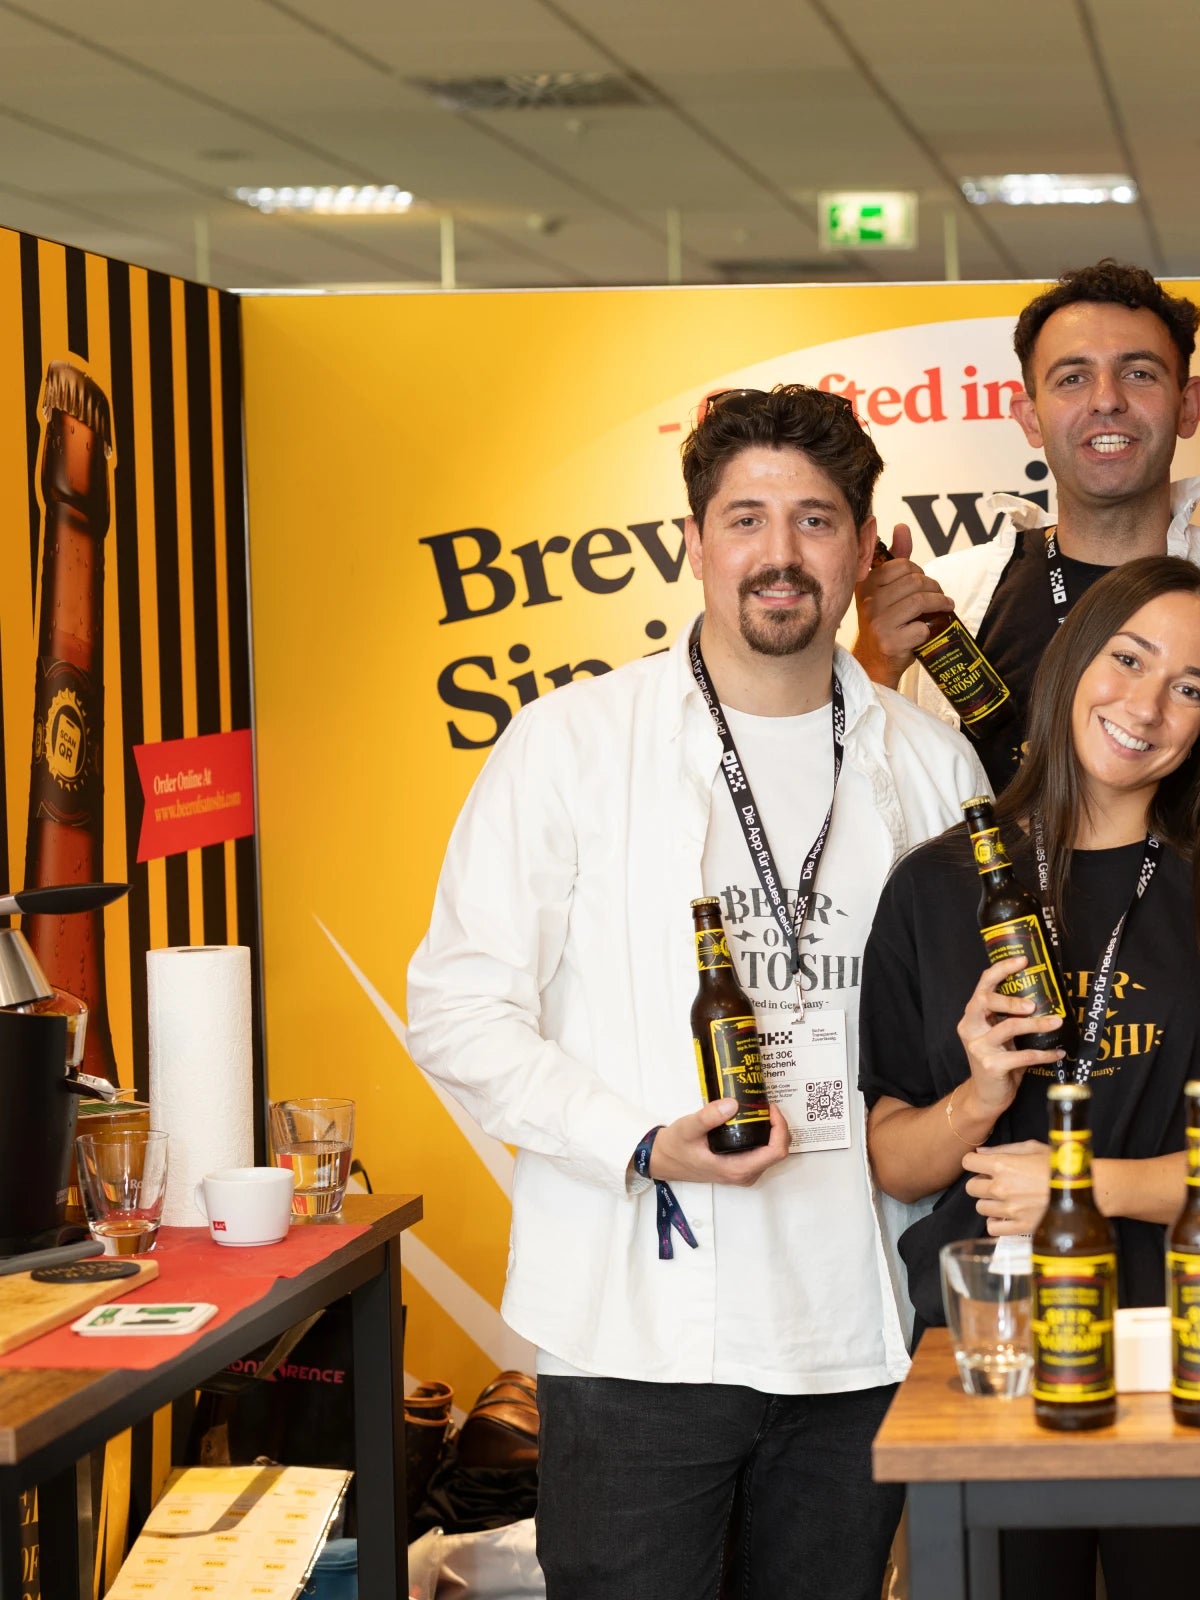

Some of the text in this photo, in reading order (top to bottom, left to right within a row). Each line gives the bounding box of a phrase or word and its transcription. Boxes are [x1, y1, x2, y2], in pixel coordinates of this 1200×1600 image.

[60, 729, 77, 748] SCAN
[58, 742, 74, 763] QR
[154, 774, 177, 795] Order
[177, 769, 203, 789] Online
[742, 805, 756, 825] Die
[748, 826, 763, 852] App
[757, 850, 770, 867] für
[803, 838, 823, 880] Die App
[762, 868, 781, 906] neues
[738, 950, 862, 992] TOSHI
[1084, 933, 1118, 1043] Die App für neues
[768, 1000, 778, 1009] in
[762, 1060, 797, 1070] eschenk
[775, 1050, 793, 1060] 30€
[763, 1069, 786, 1079] chern
